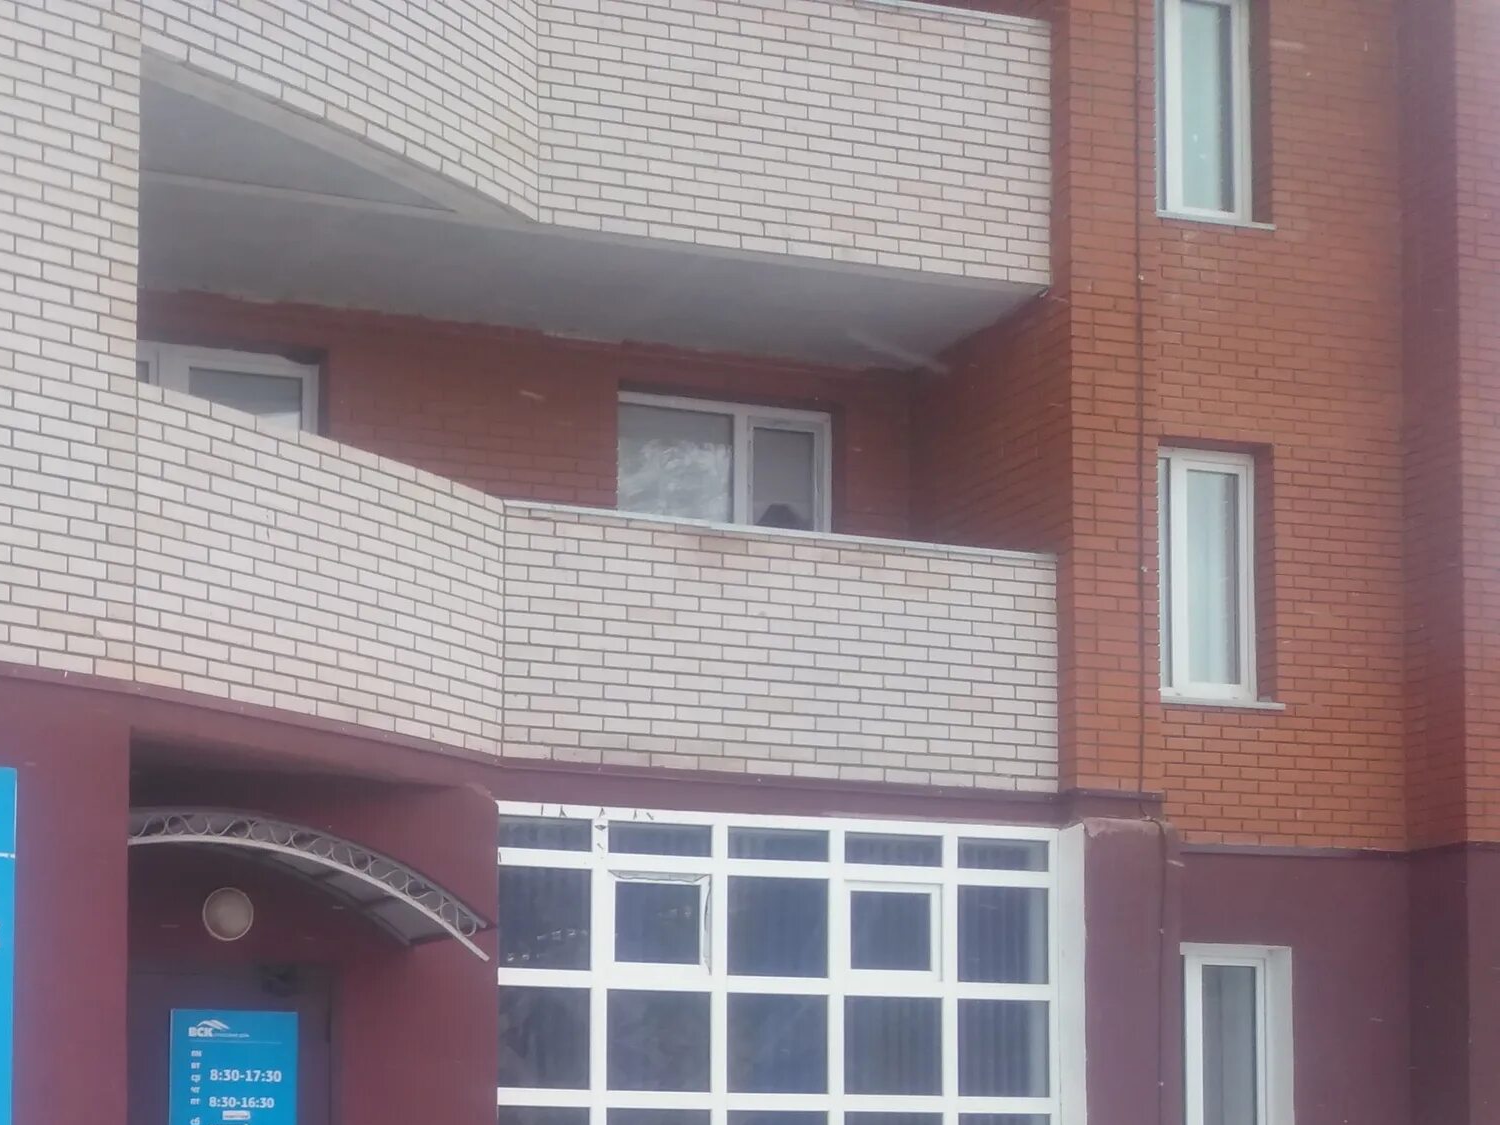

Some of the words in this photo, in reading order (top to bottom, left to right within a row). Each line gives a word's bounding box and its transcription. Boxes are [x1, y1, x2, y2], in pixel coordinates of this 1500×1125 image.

[188, 1027, 213, 1037] ВСК
[209, 1069, 282, 1083] 8:30-17:30
[208, 1096, 275, 1108] 8:30-16:30
